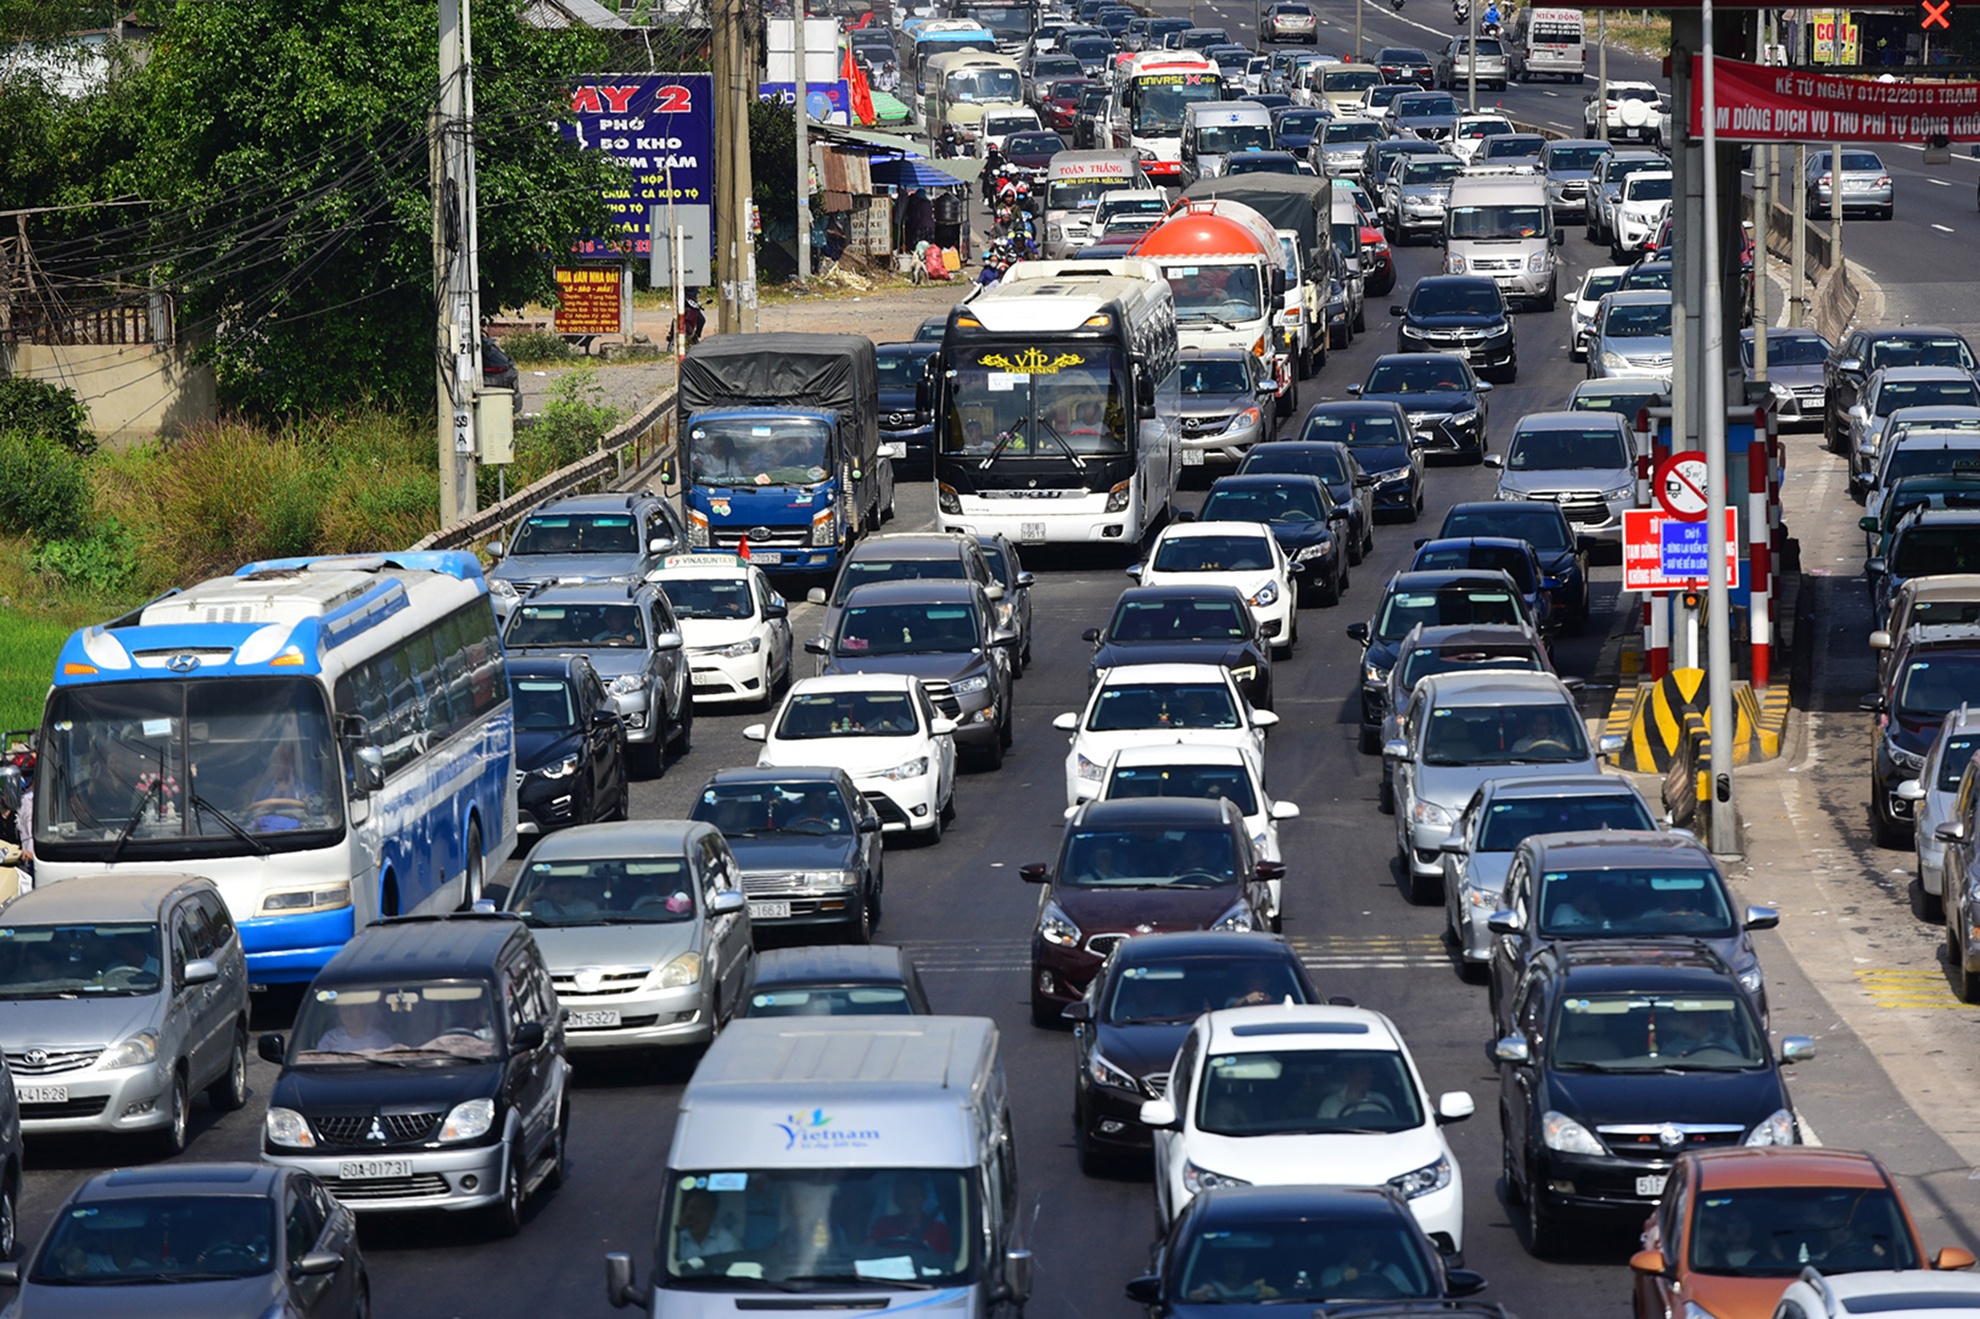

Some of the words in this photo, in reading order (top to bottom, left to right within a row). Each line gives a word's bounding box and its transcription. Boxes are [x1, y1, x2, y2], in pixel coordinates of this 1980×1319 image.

[653, 85, 691, 113] 2
[1797, 77, 1814, 96] TỪ
[1817, 81, 1854, 100] NGÀY
[1858, 86, 1934, 104] 01/12/2018
[1939, 87, 1977, 107] TRẠM
[1733, 103, 1770, 131] DỪNG
[1775, 109, 1807, 137] DỊCH
[1812, 110, 1829, 138] VỤ
[1833, 111, 1859, 134] THU
[1862, 112, 1886, 134] PHÍ
[1890, 114, 1908, 140] TỰ
[1911, 113, 1949, 140] ĐỘNG
[637, 138, 682, 149] KHO
[654, 153, 697, 168] TẤM
[1014, 350, 1049, 367] VIP
